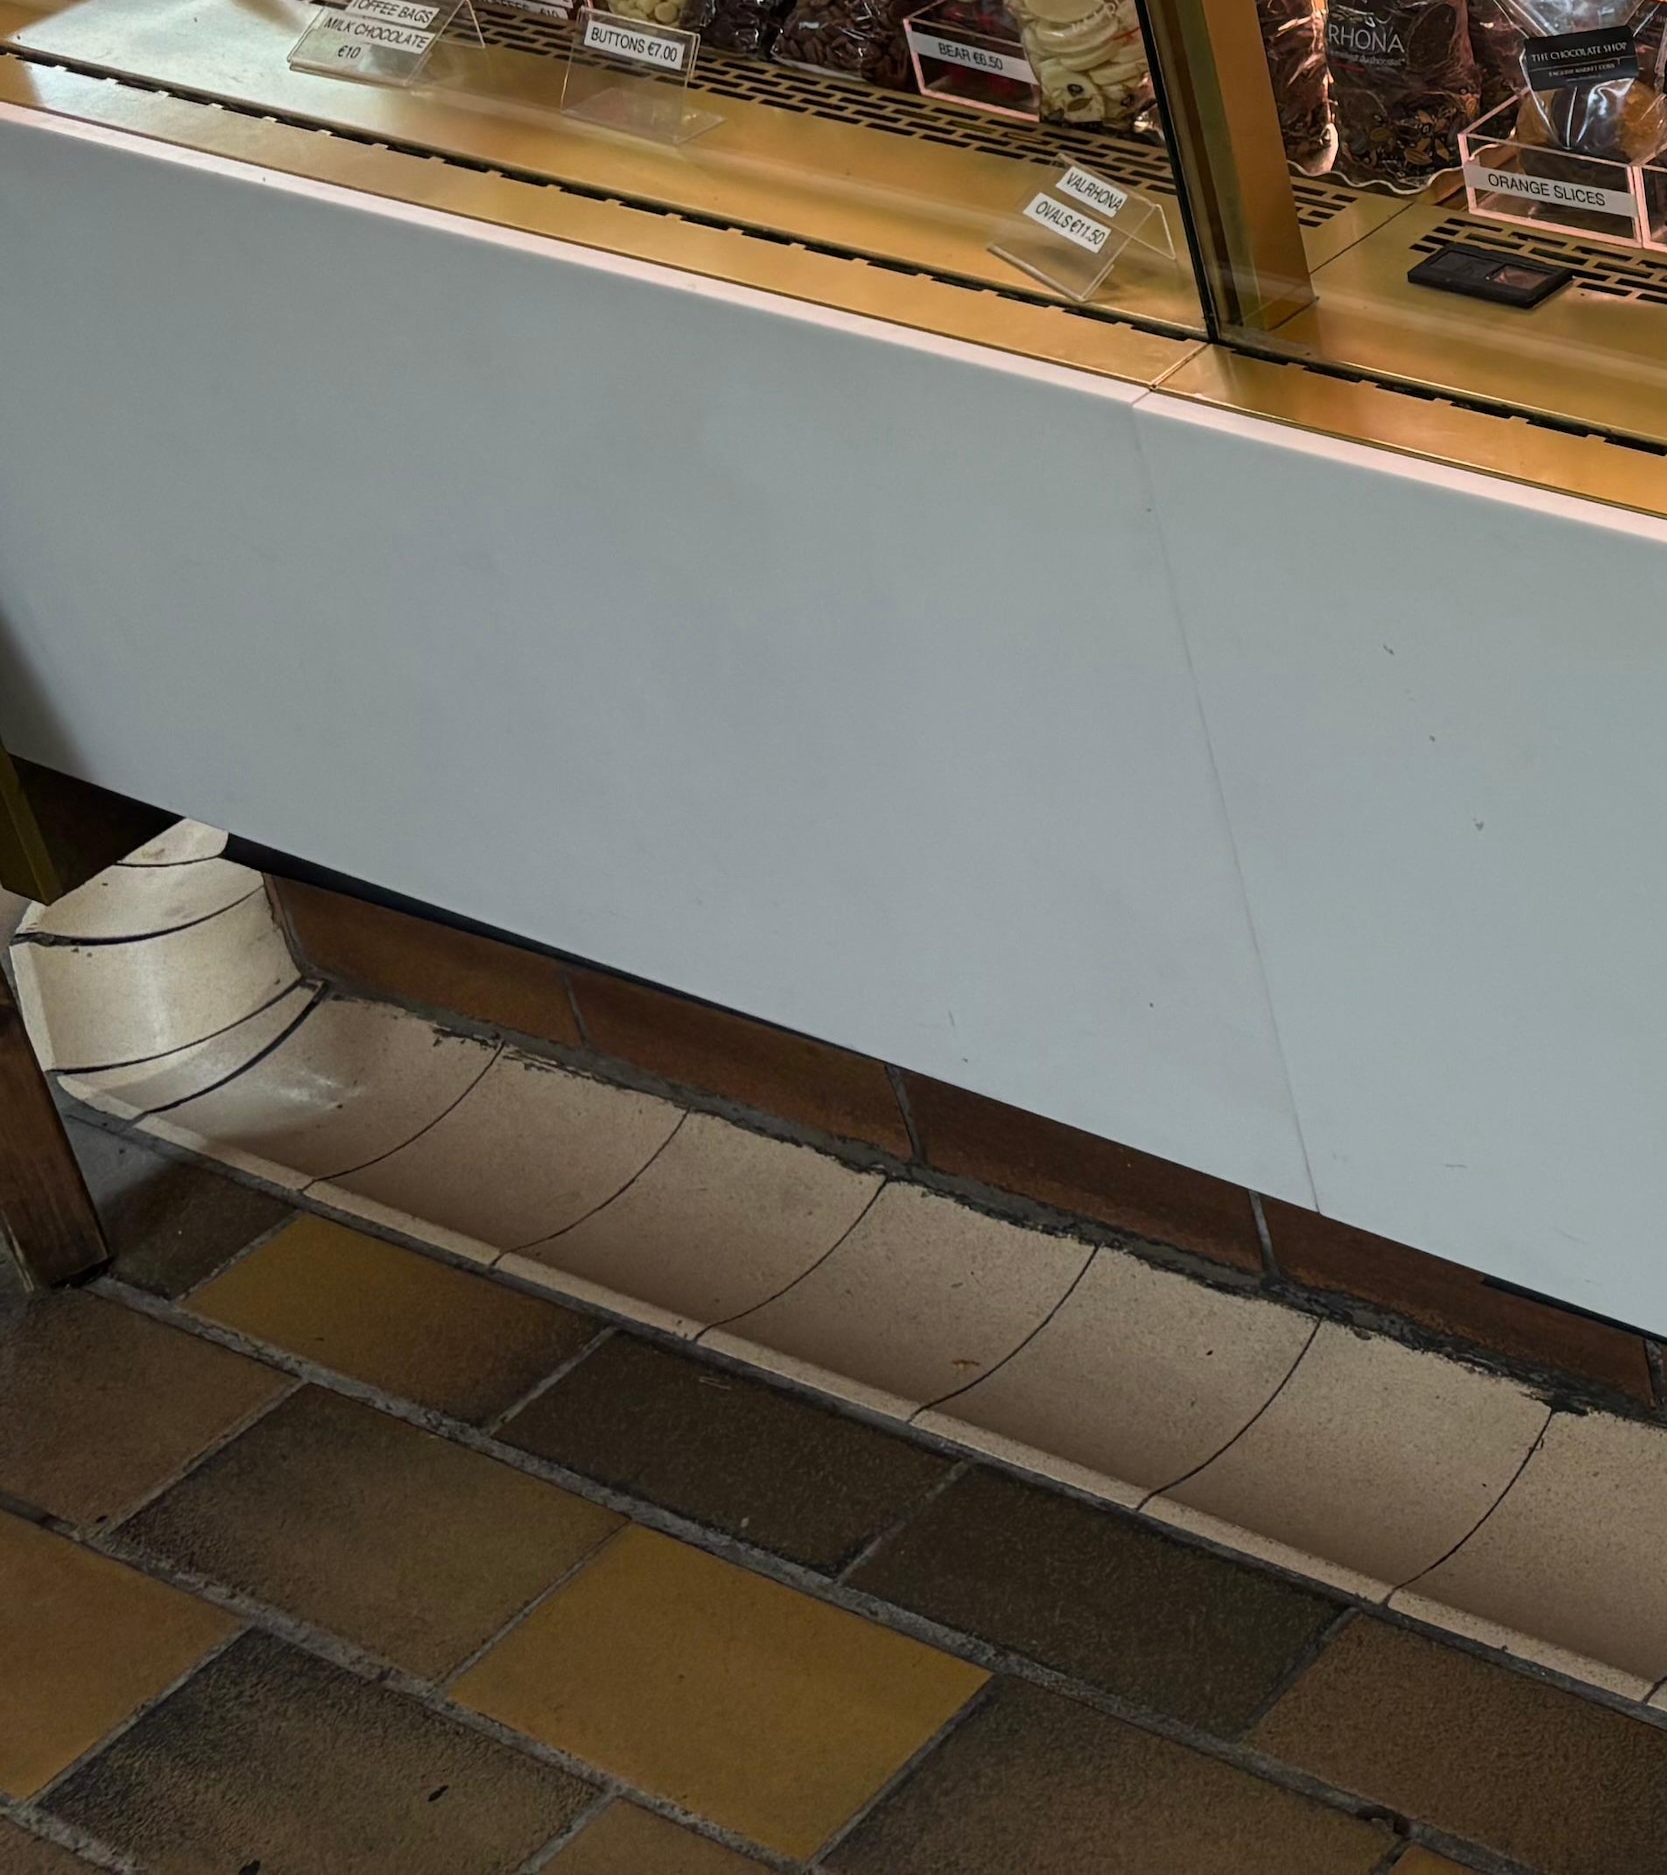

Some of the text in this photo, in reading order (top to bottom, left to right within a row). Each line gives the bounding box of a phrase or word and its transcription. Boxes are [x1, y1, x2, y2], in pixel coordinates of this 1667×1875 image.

[400, 5, 433, 24] BAGS
[324, 16, 428, 49] MILK CHOCOLATE
[590, 27, 679, 63] BUTTONS €7.00
[337, 44, 362, 60] €10
[1066, 172, 1121, 212] VALRHONA
[1486, 172, 1606, 208] ORANGE SLICES
